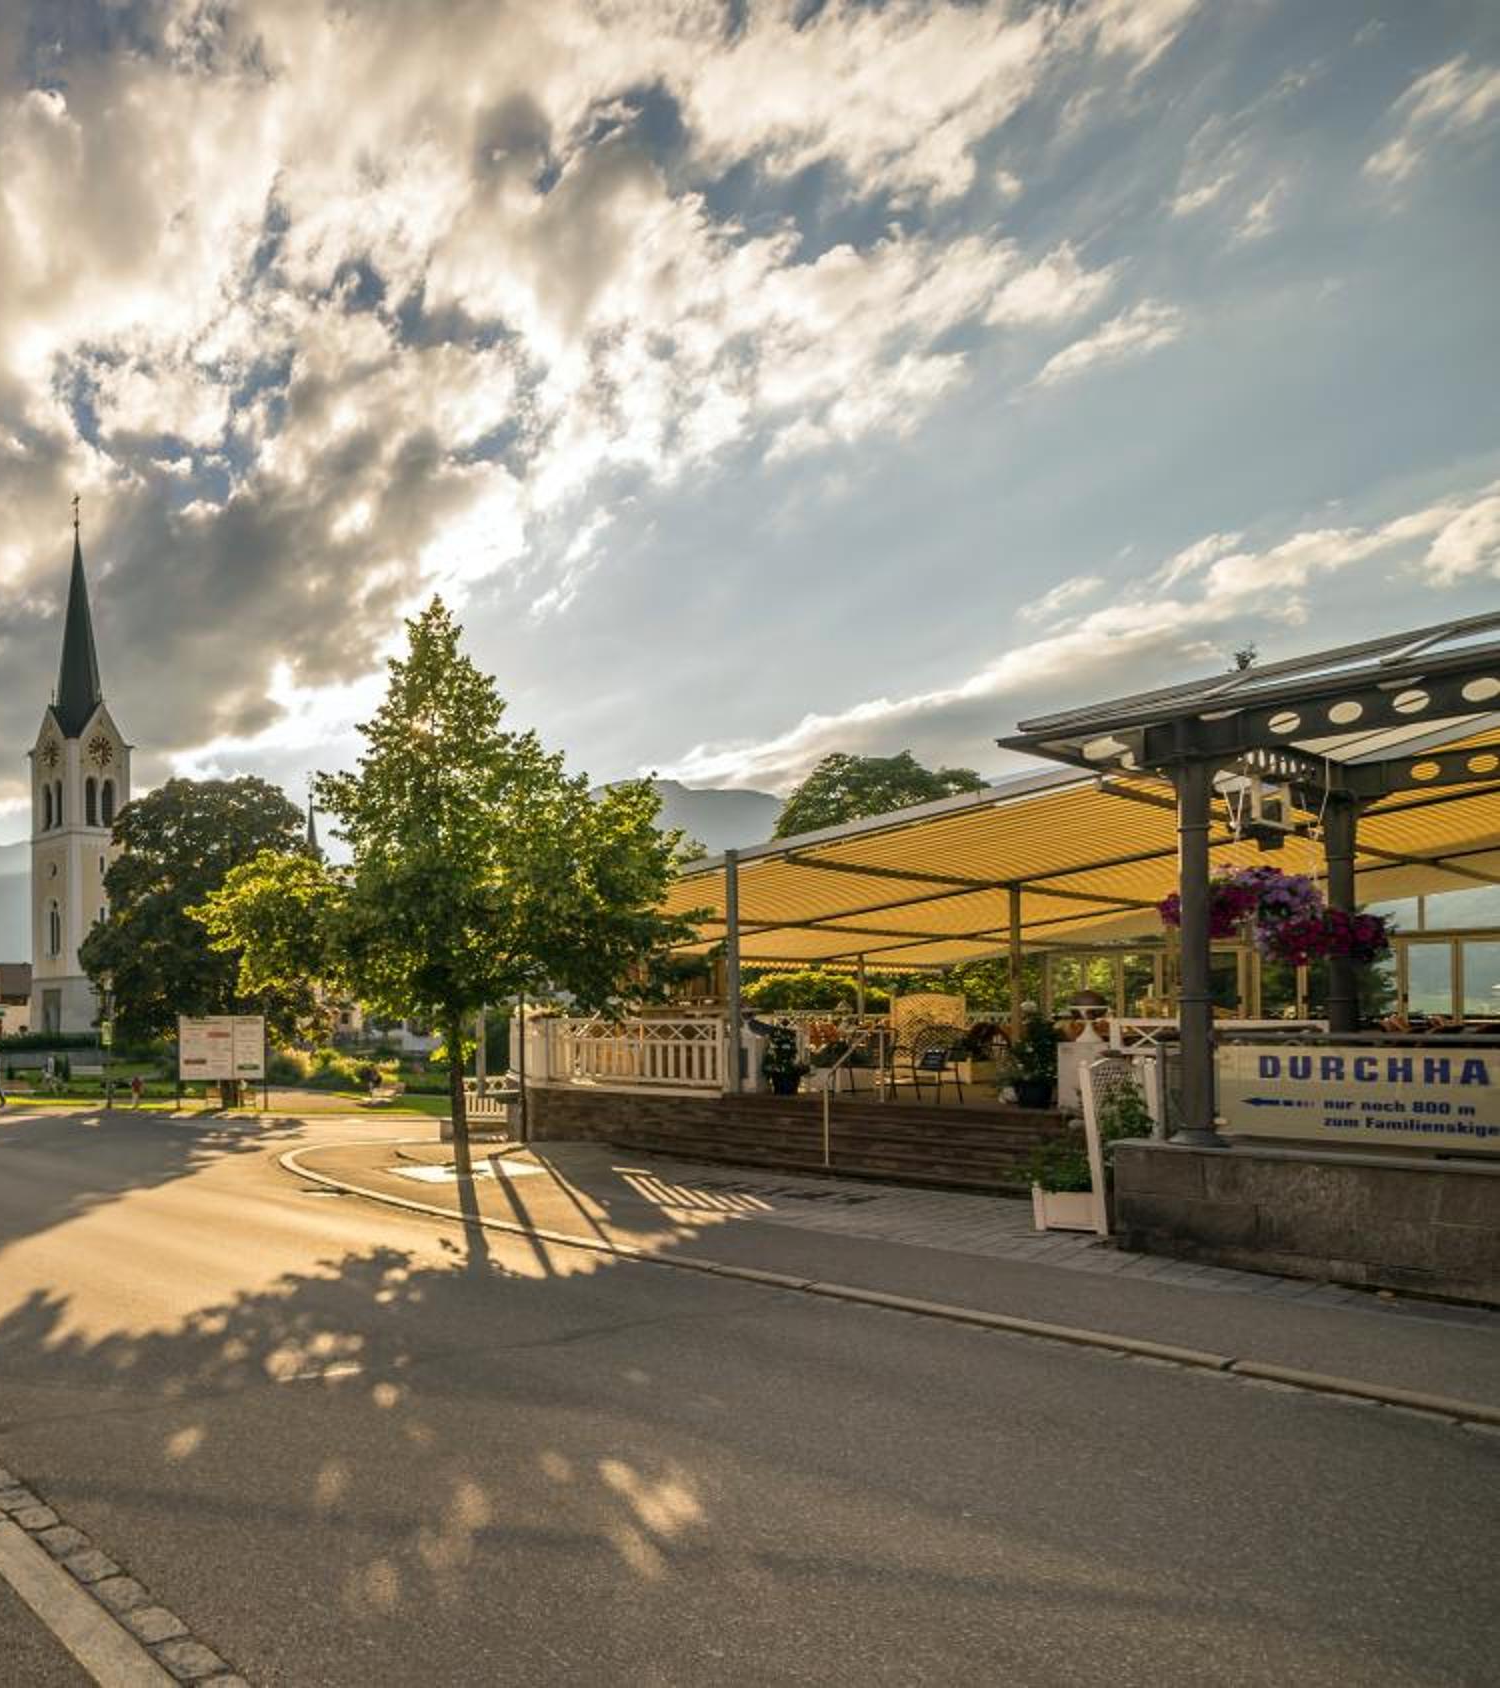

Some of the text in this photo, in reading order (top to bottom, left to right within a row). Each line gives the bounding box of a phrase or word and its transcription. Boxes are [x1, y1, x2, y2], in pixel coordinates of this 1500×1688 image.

[1258, 1055, 1491, 1086] DURCHHA
[1323, 1100, 1475, 1115] nur noch 800 m
[1323, 1117, 1358, 1127] zum
